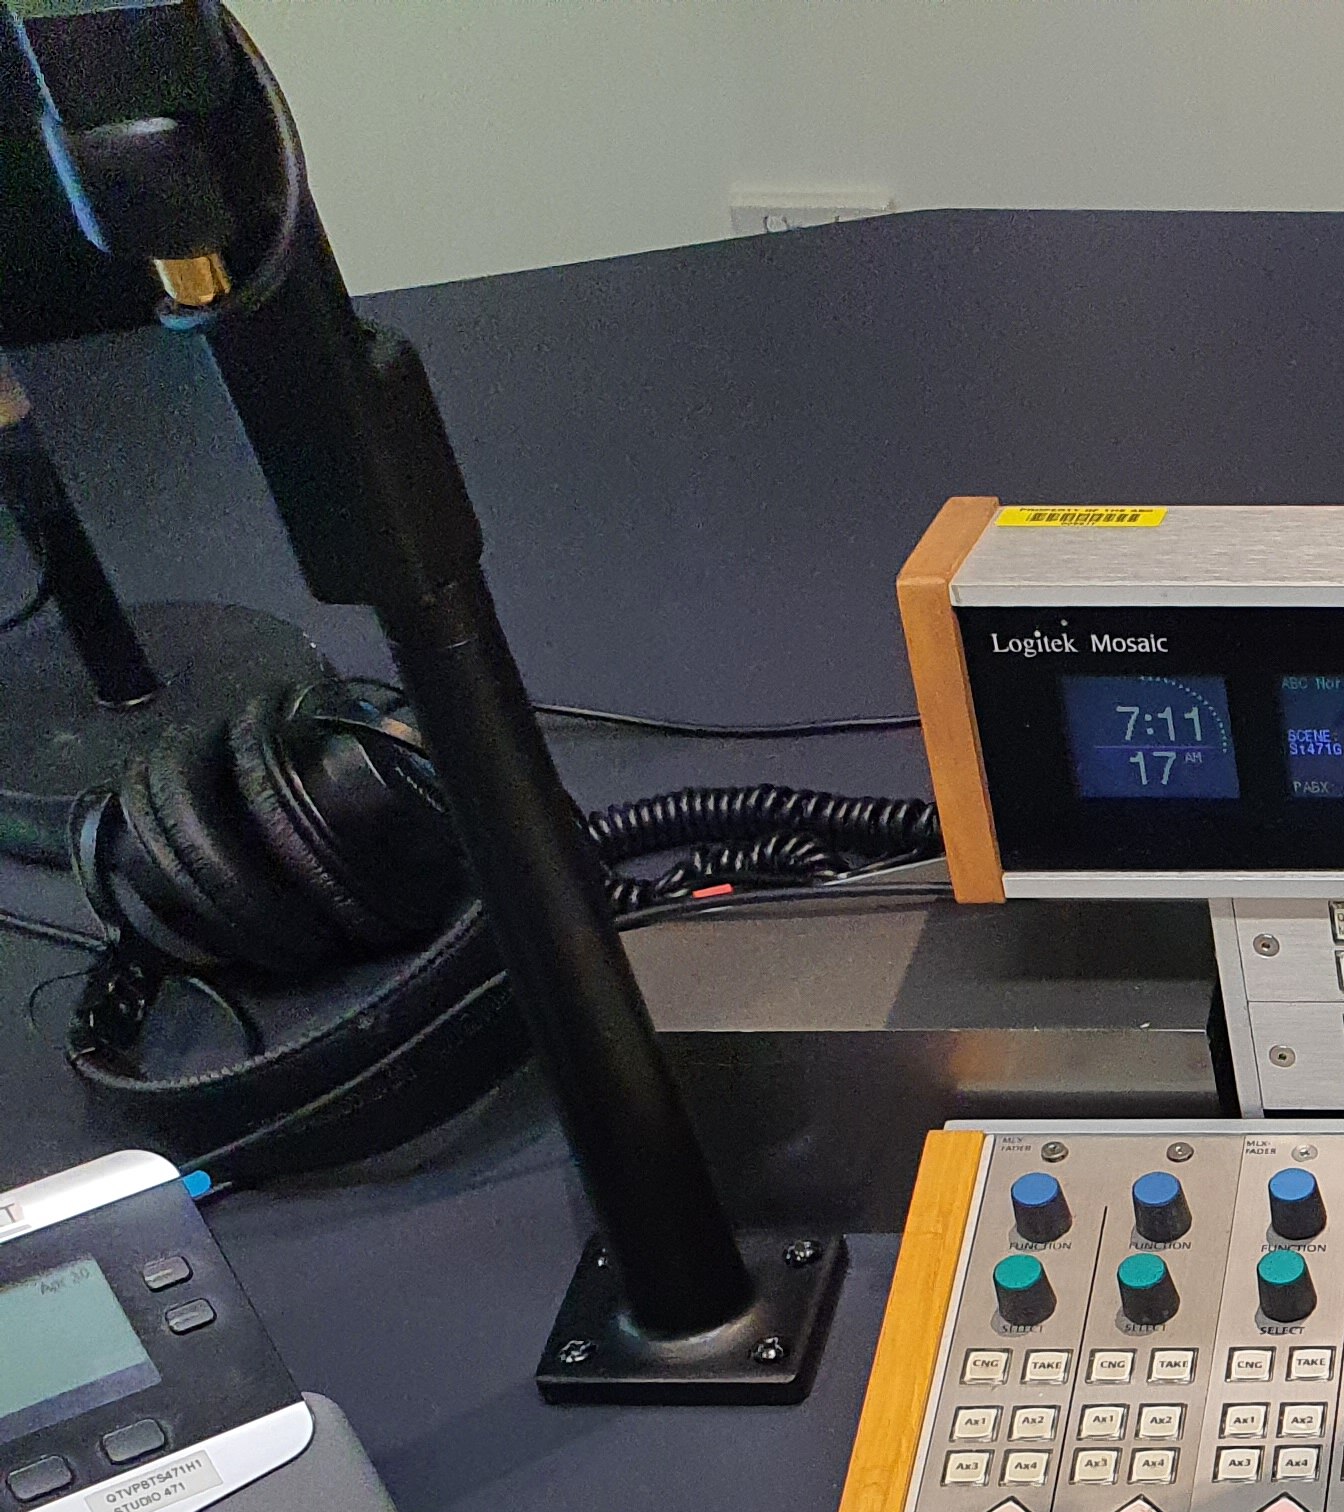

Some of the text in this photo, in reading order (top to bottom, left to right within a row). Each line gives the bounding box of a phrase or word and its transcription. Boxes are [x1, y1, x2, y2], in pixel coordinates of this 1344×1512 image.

[991, 629, 1168, 658] Logitek Mosaic
[1116, 706, 1202, 741] 7:11
[1130, 751, 1176, 785] 17
[1009, 1241, 1072, 1251] FUNCTION
[1259, 1325, 1305, 1335] SELECT
[972, 1359, 999, 1369] CNG
[1032, 1361, 1062, 1371] TAKE
[1021, 1415, 1045, 1426] Ax2
[1015, 1461, 1037, 1471] Ax4
[163, 1482, 186, 1504] 471
